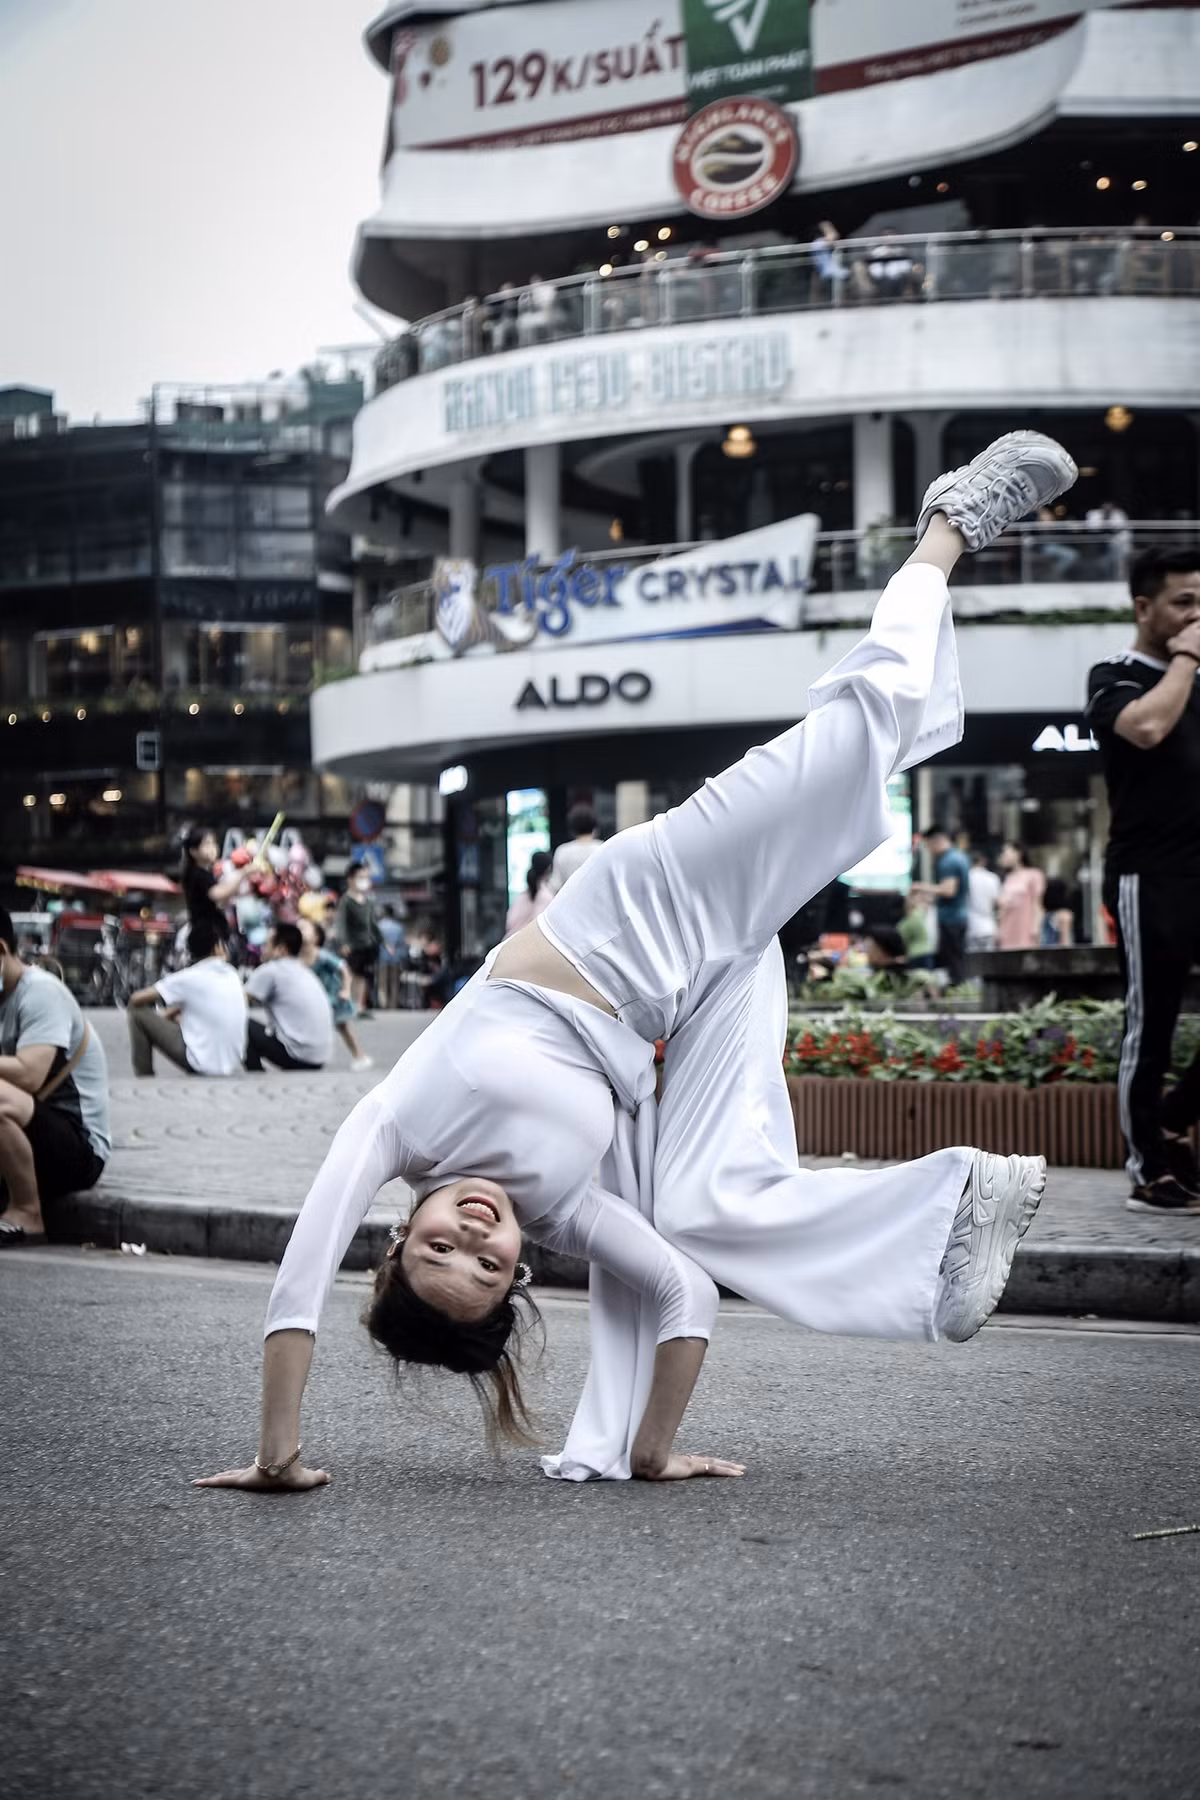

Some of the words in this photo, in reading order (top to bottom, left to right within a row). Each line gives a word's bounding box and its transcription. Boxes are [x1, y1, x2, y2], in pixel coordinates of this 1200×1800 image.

[690, 174, 778, 210] COFFEE
[484, 546, 632, 636] Tiger
[636, 558, 812, 602] CRYSTAL
[515, 671, 653, 711] ALDO
[1032, 723, 1100, 752] AL
